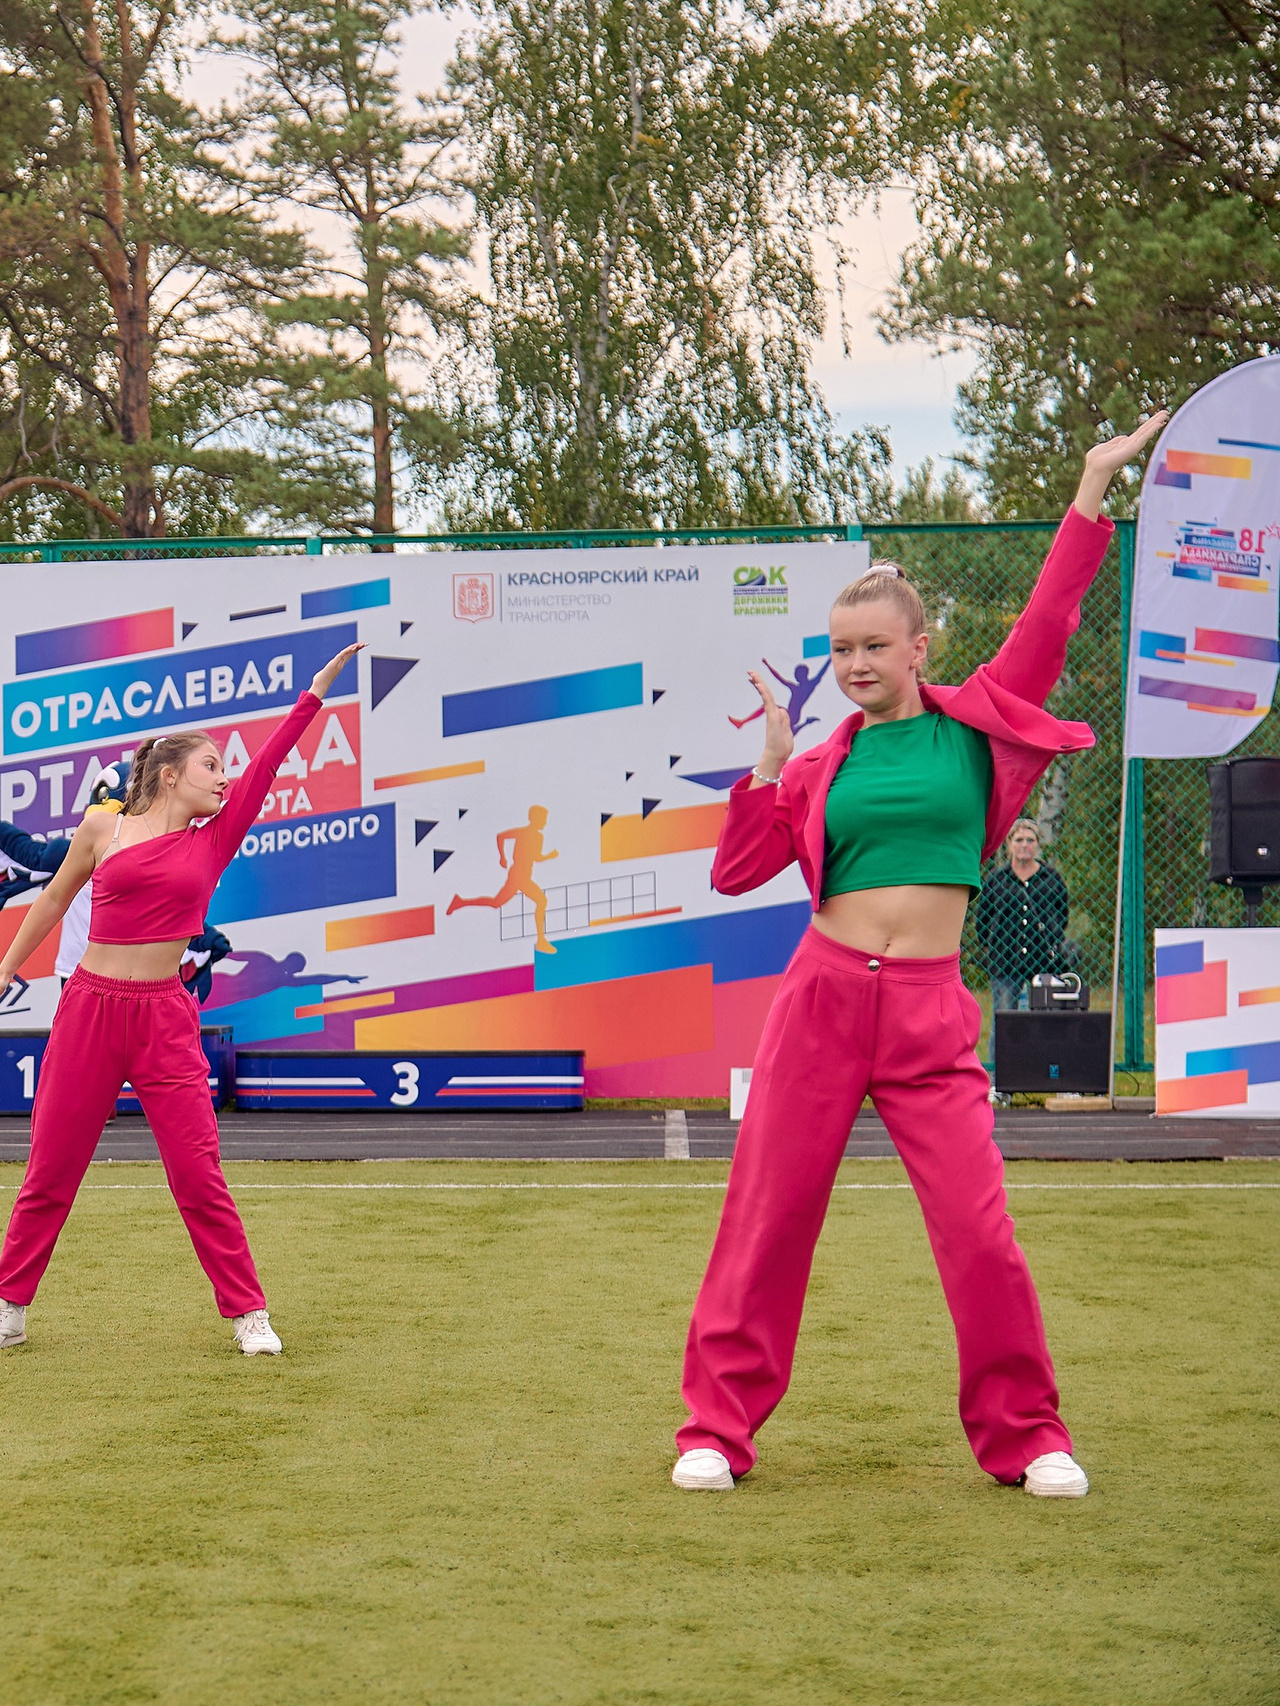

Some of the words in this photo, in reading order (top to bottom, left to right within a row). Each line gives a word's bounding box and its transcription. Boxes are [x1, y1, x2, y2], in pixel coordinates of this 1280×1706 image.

[507, 566, 649, 586] КРАСНОЯРСКИЙ
[653, 564, 700, 583] КРАЙ
[507, 593, 613, 608] МИНИСТЕРСТВО
[508, 609, 591, 623] ТРАНСПОРТА
[10, 653, 294, 739] ОТРАСЛЕВАЯ
[16, 1055, 35, 1099] 1
[390, 1061, 419, 1104] 3
